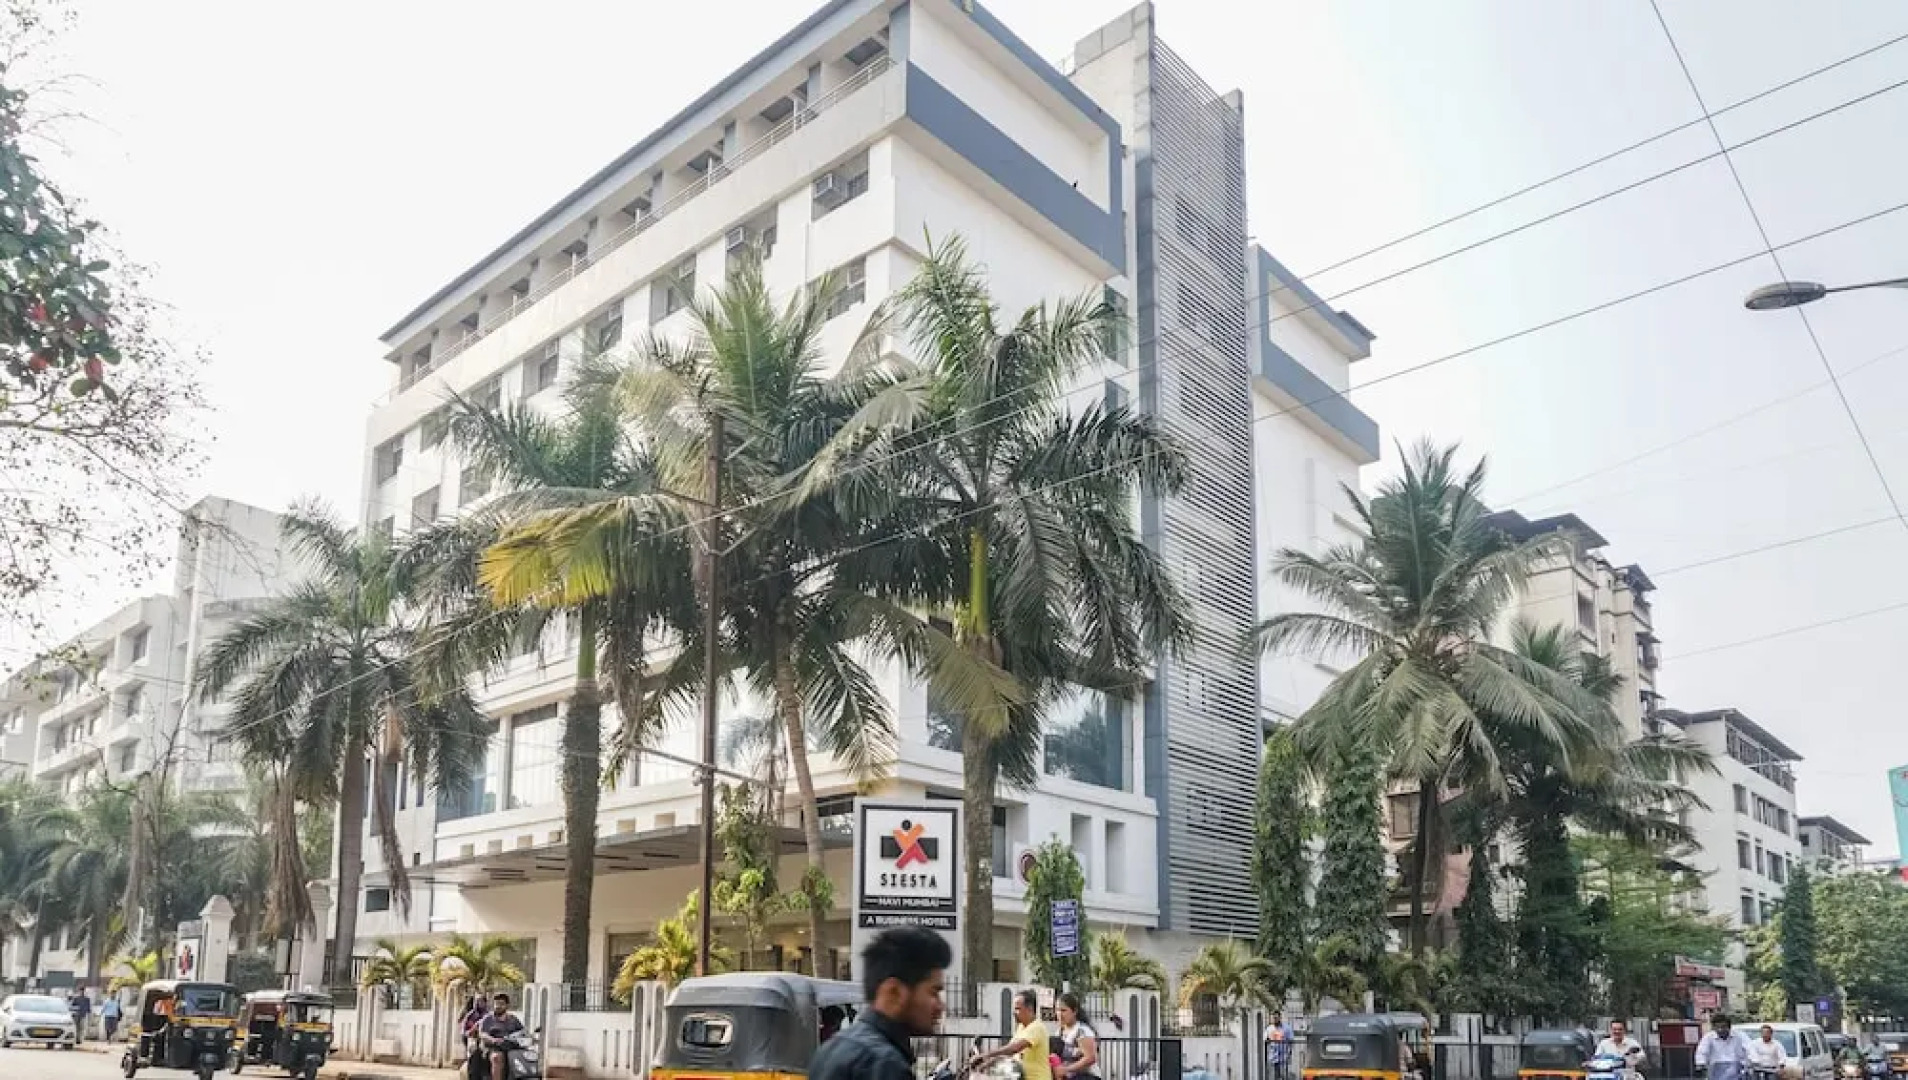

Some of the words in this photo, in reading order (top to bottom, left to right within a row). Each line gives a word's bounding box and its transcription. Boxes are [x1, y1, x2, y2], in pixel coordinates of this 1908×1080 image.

[880, 873, 938, 888] SIESTA
[879, 898, 900, 907] NAVI
[901, 898, 940, 908] MUMBAI
[866, 915, 875, 925] A
[876, 915, 919, 926] BUSINESS
[921, 916, 951, 926] HOTEL
